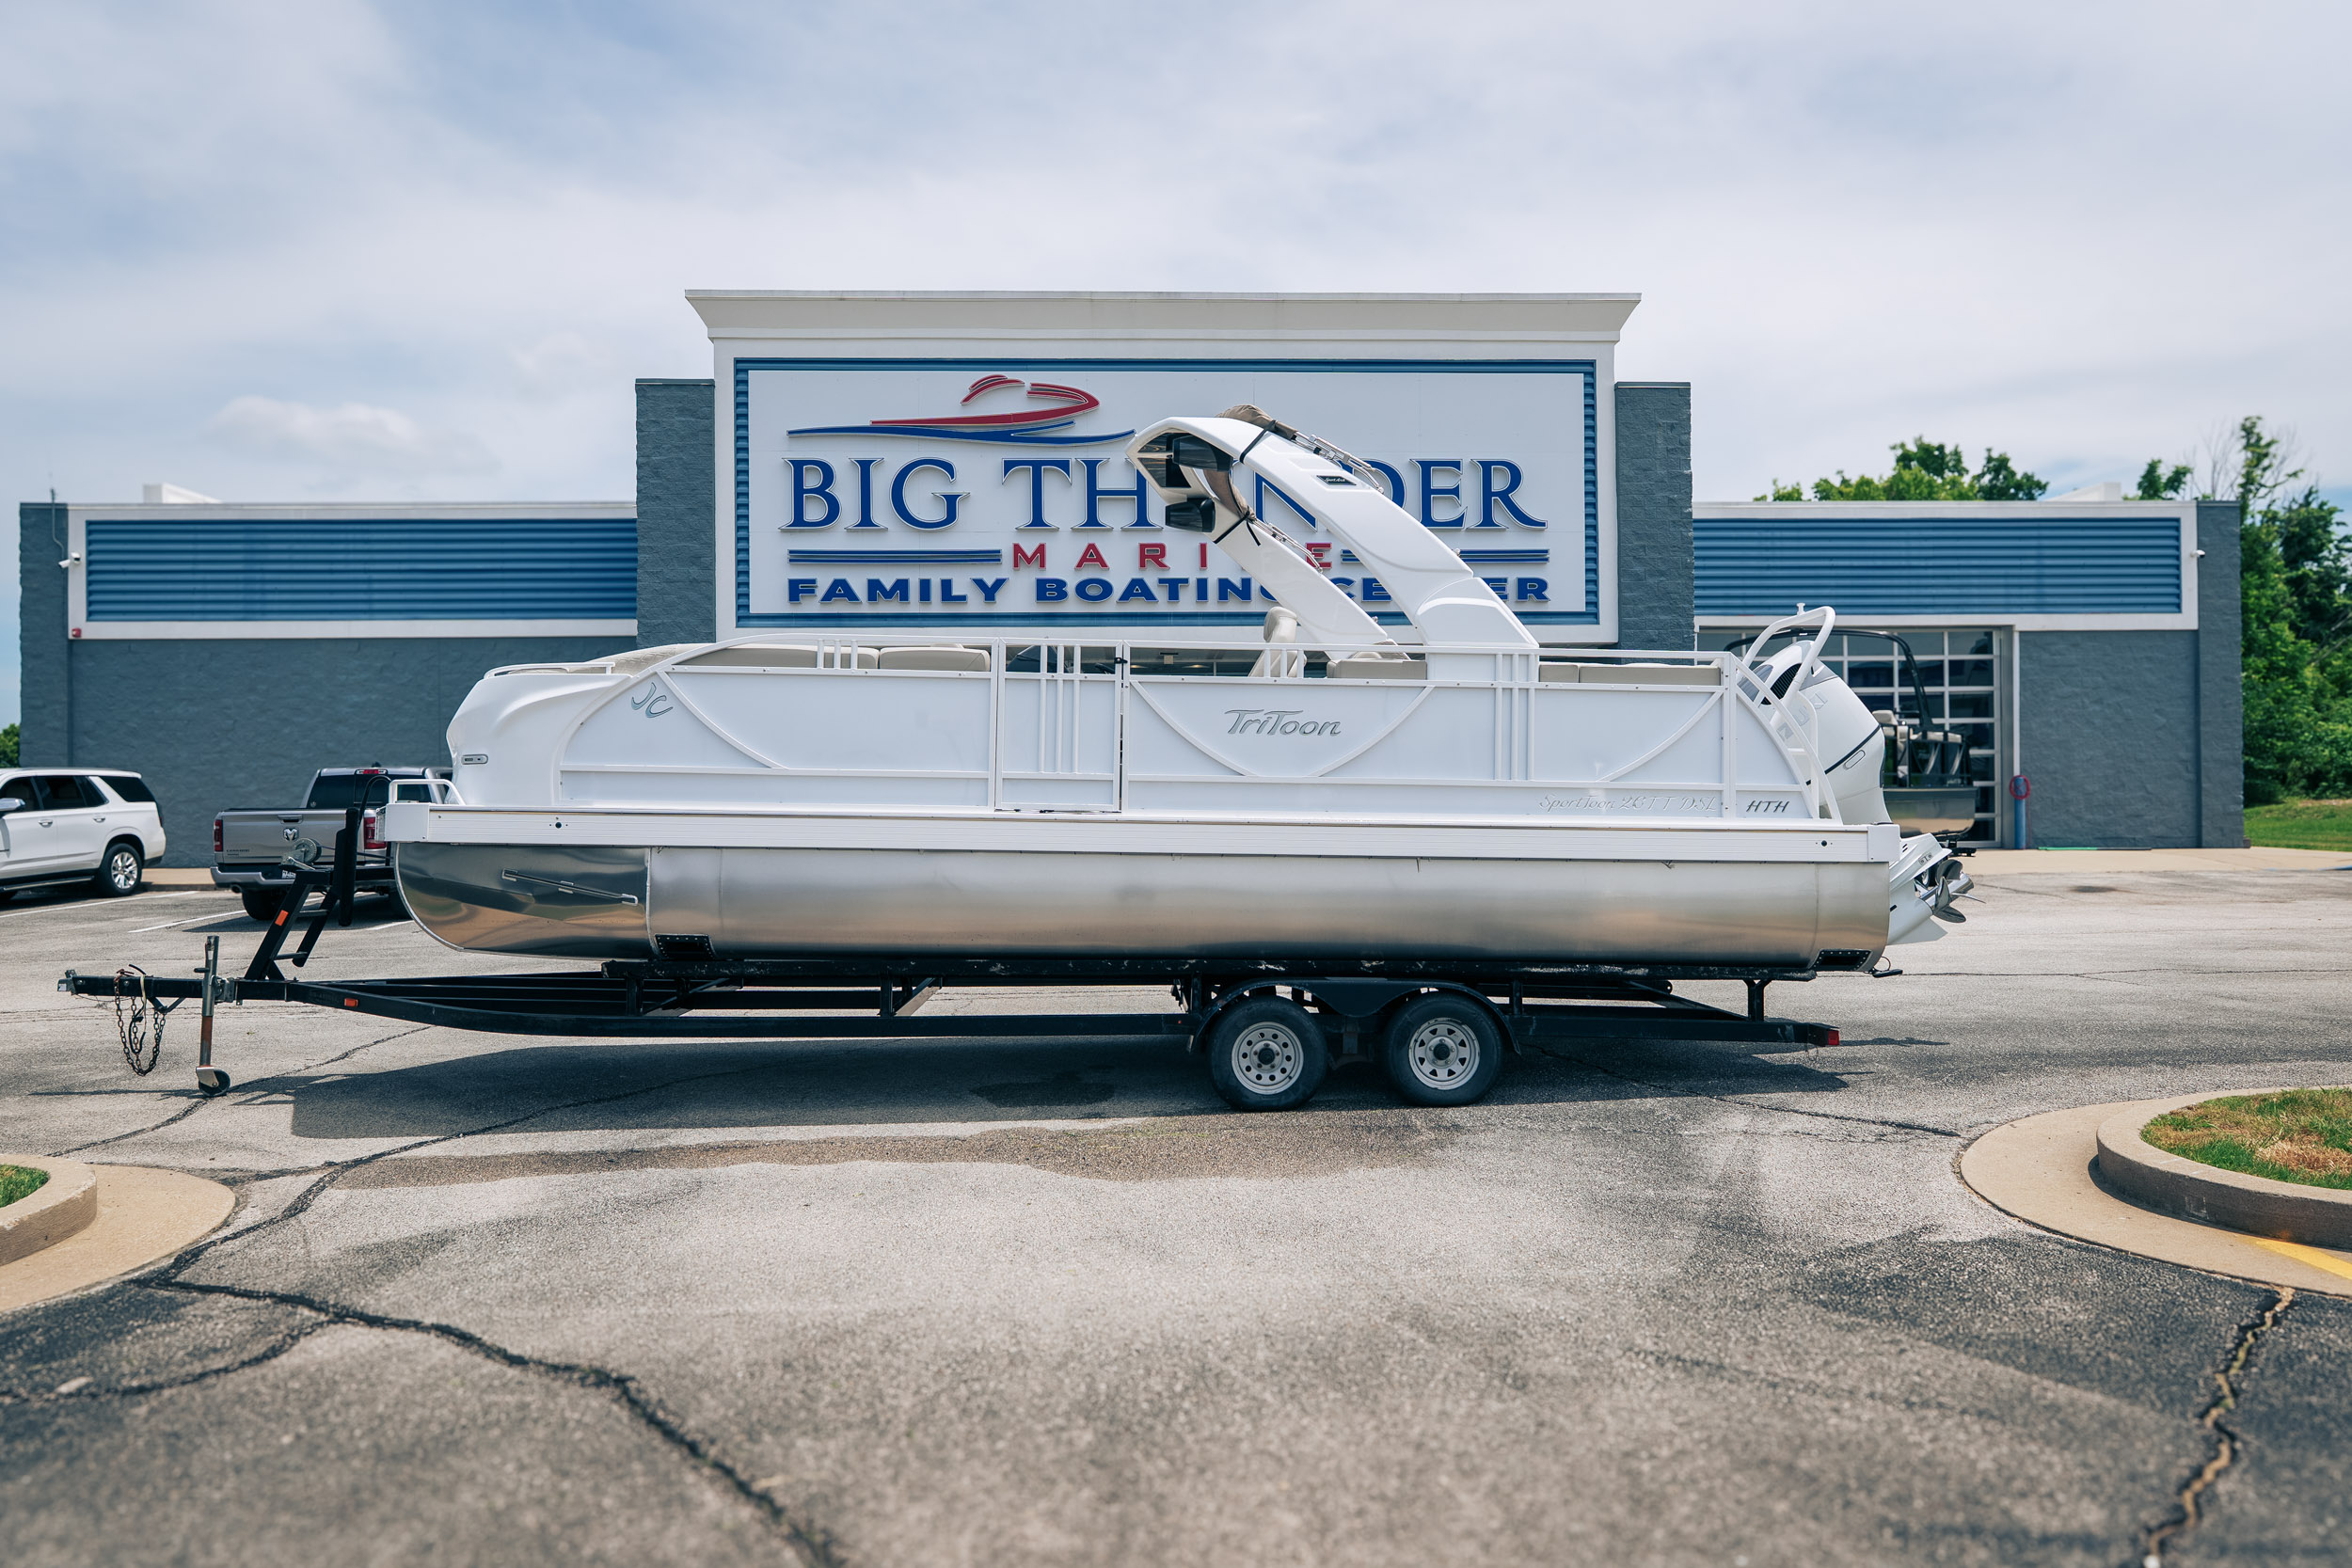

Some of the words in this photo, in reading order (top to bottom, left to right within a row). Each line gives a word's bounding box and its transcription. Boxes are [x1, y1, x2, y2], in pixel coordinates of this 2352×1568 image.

[778, 456, 971, 531] BIG
[1001, 457, 1549, 531] THNDER
[1011, 542, 1333, 570] MARIE
[787, 577, 1009, 604] FAMILY
[1327, 577, 1551, 603] CEER
[1223, 708, 1343, 736] TriToon
[1538, 794, 1616, 814] SportToon
[1745, 800, 1790, 813] HTH
